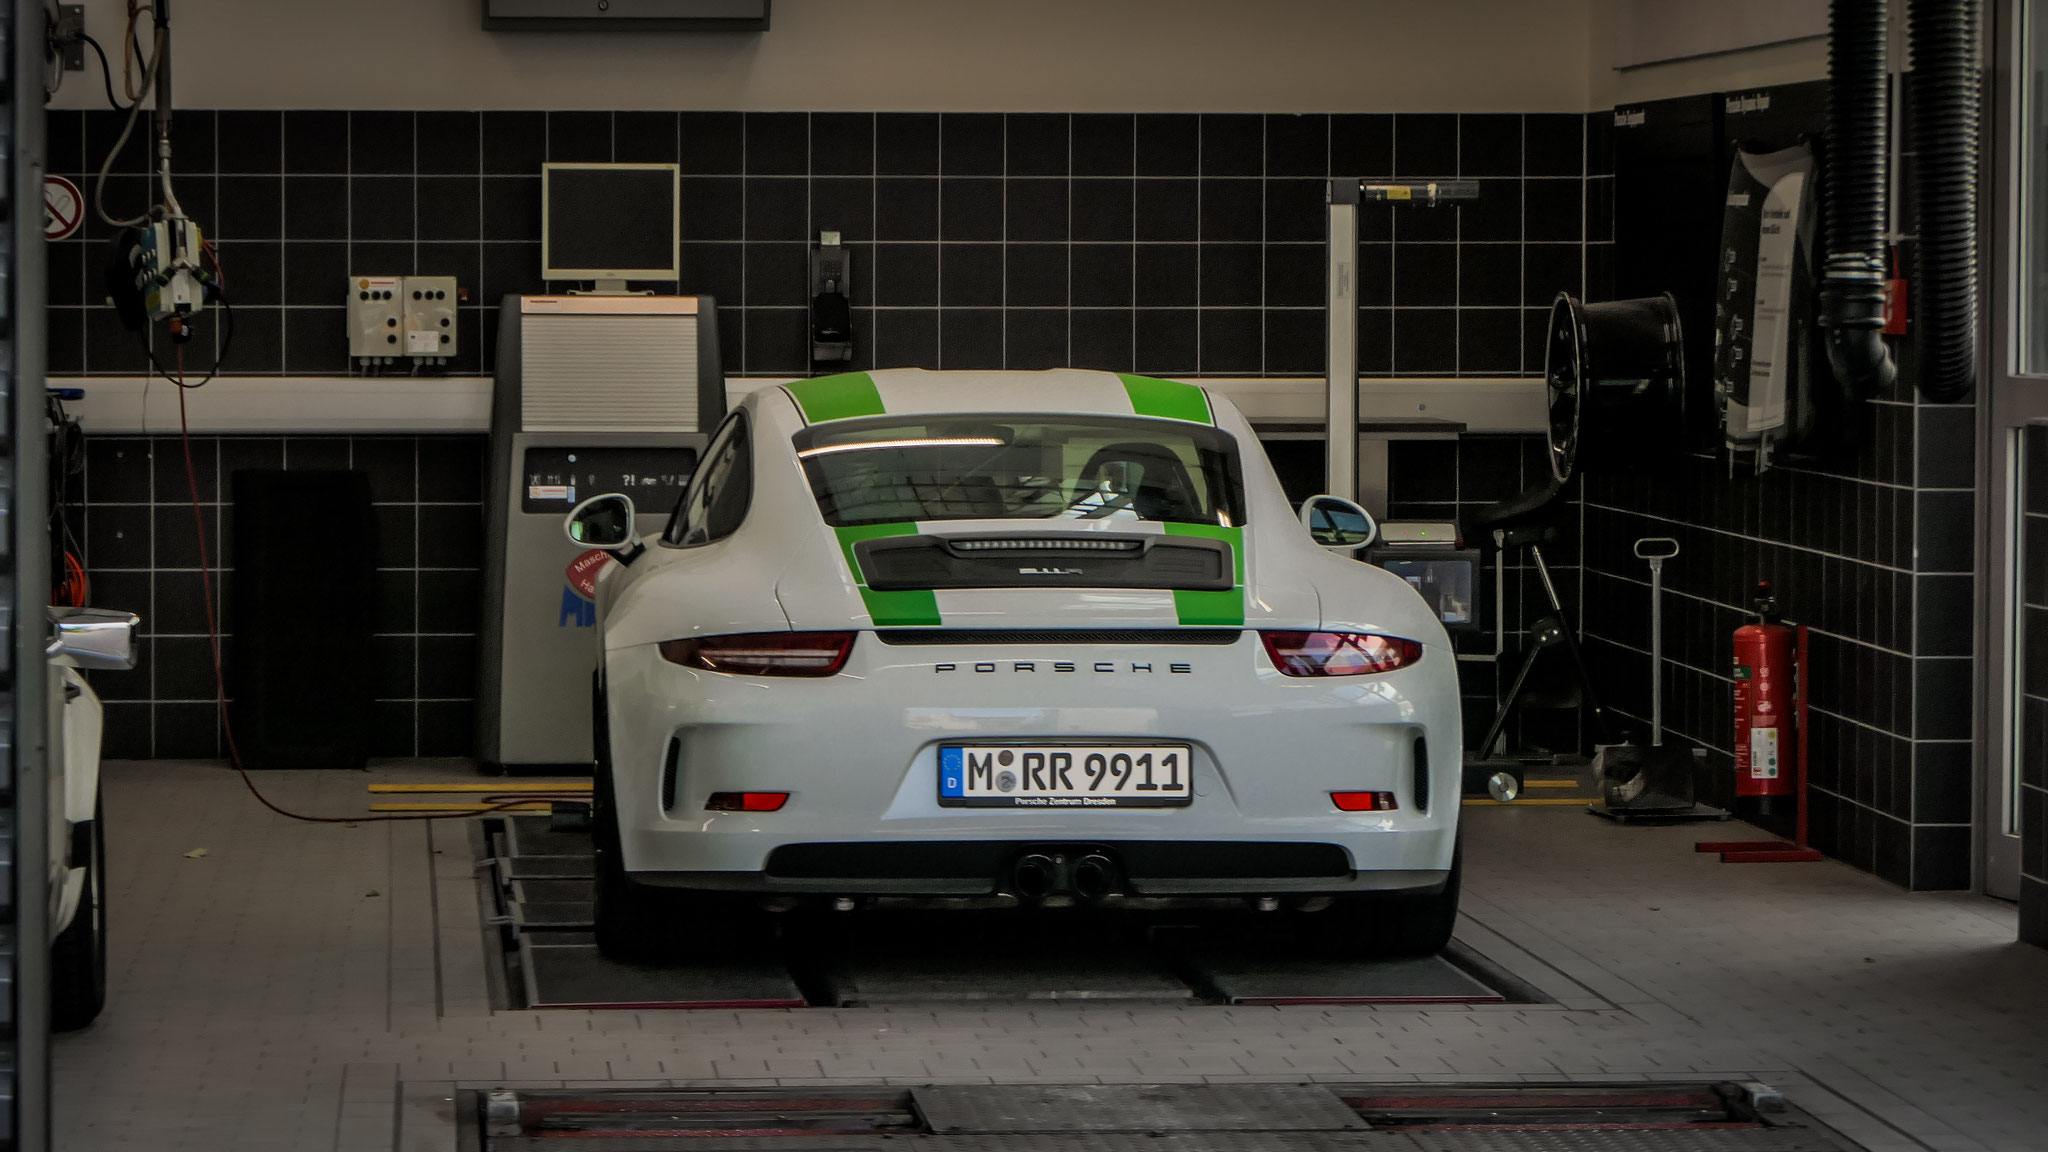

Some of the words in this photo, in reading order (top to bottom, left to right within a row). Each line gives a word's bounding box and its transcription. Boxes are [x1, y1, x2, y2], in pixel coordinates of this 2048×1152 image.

[935, 662, 1191, 674] PORSCHE
[968, 752, 993, 791] M
[1022, 752, 1074, 791] RR
[1084, 752, 1184, 791] 9911
[947, 777, 957, 789] D
[1014, 797, 1047, 805] Porsche
[1048, 797, 1082, 805] Zentrum
[1083, 797, 1117, 805] Dresden
